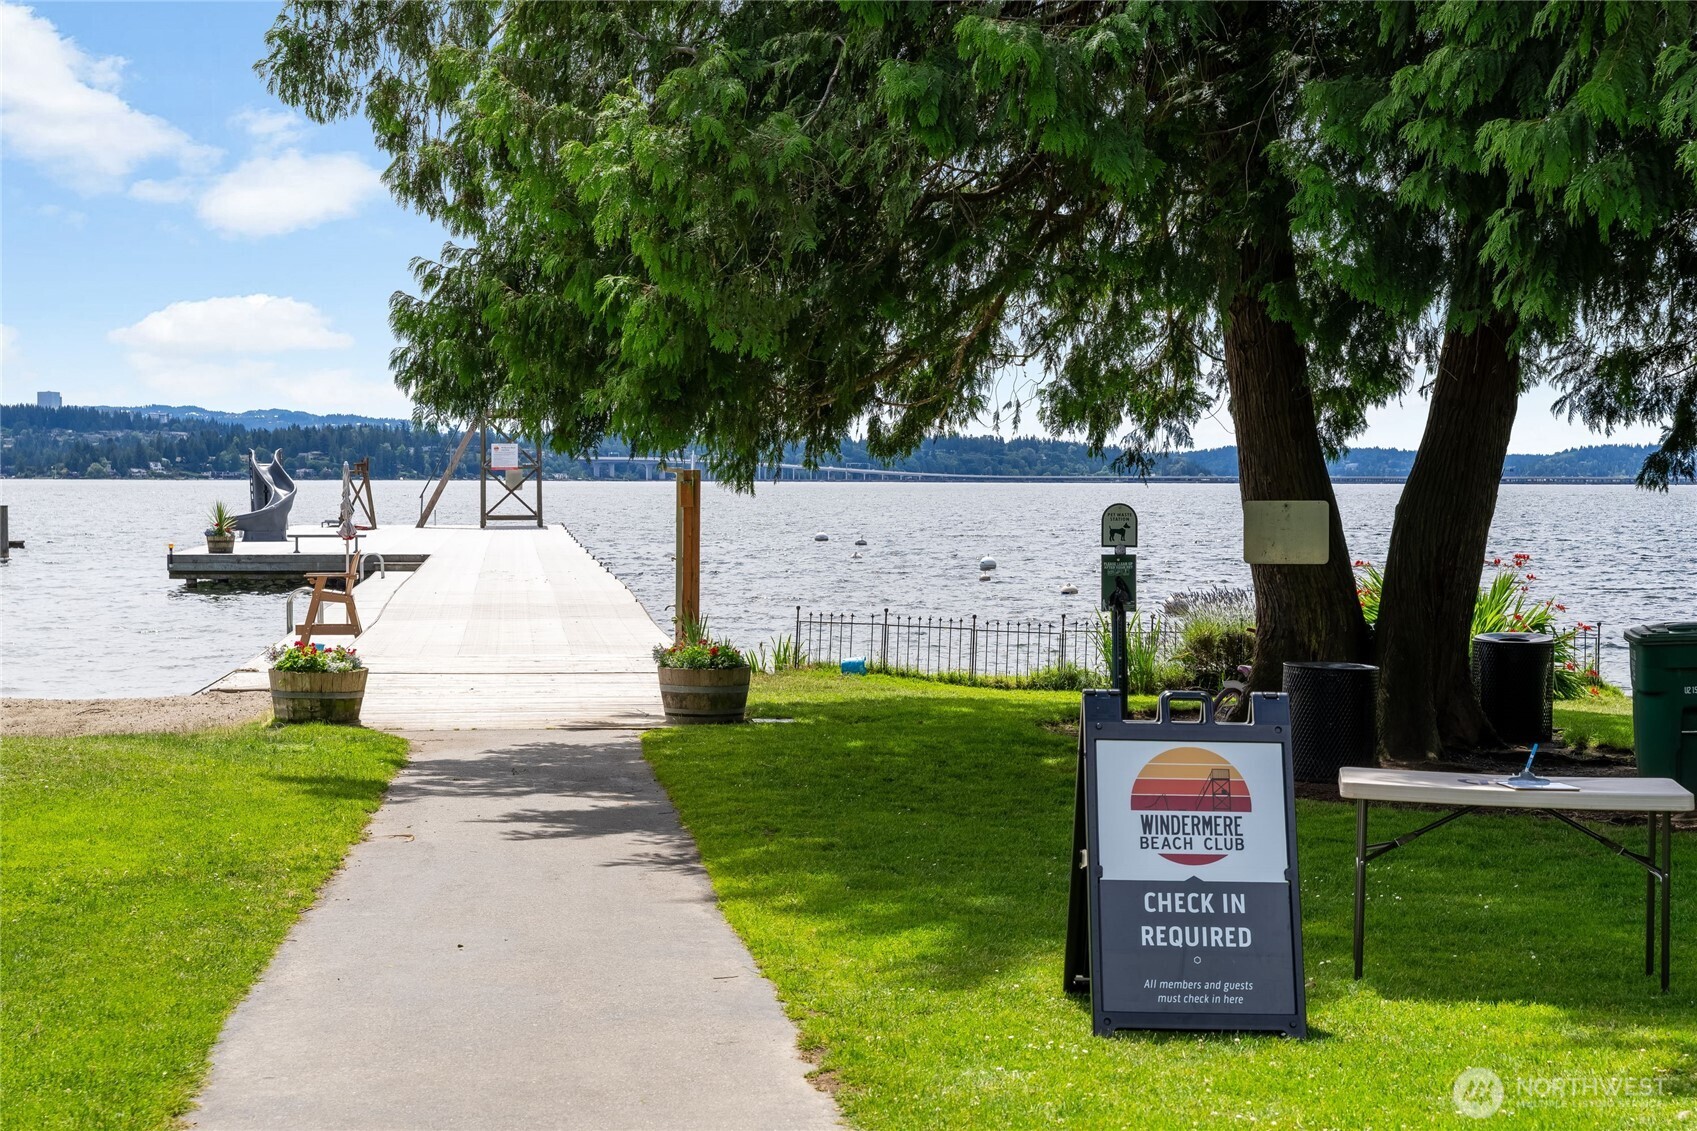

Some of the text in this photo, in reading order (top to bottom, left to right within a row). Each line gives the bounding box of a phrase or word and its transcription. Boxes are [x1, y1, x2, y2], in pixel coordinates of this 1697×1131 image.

[1140, 814, 1243, 837] WINDERMERE
[1140, 836, 1245, 851] BEACH CLUB
[1144, 892, 1246, 914] CHECK IN
[1141, 925, 1252, 948] REQUIRED
[1144, 979, 1253, 993] All members and guests
[1157, 993, 1244, 1004] must check in here
